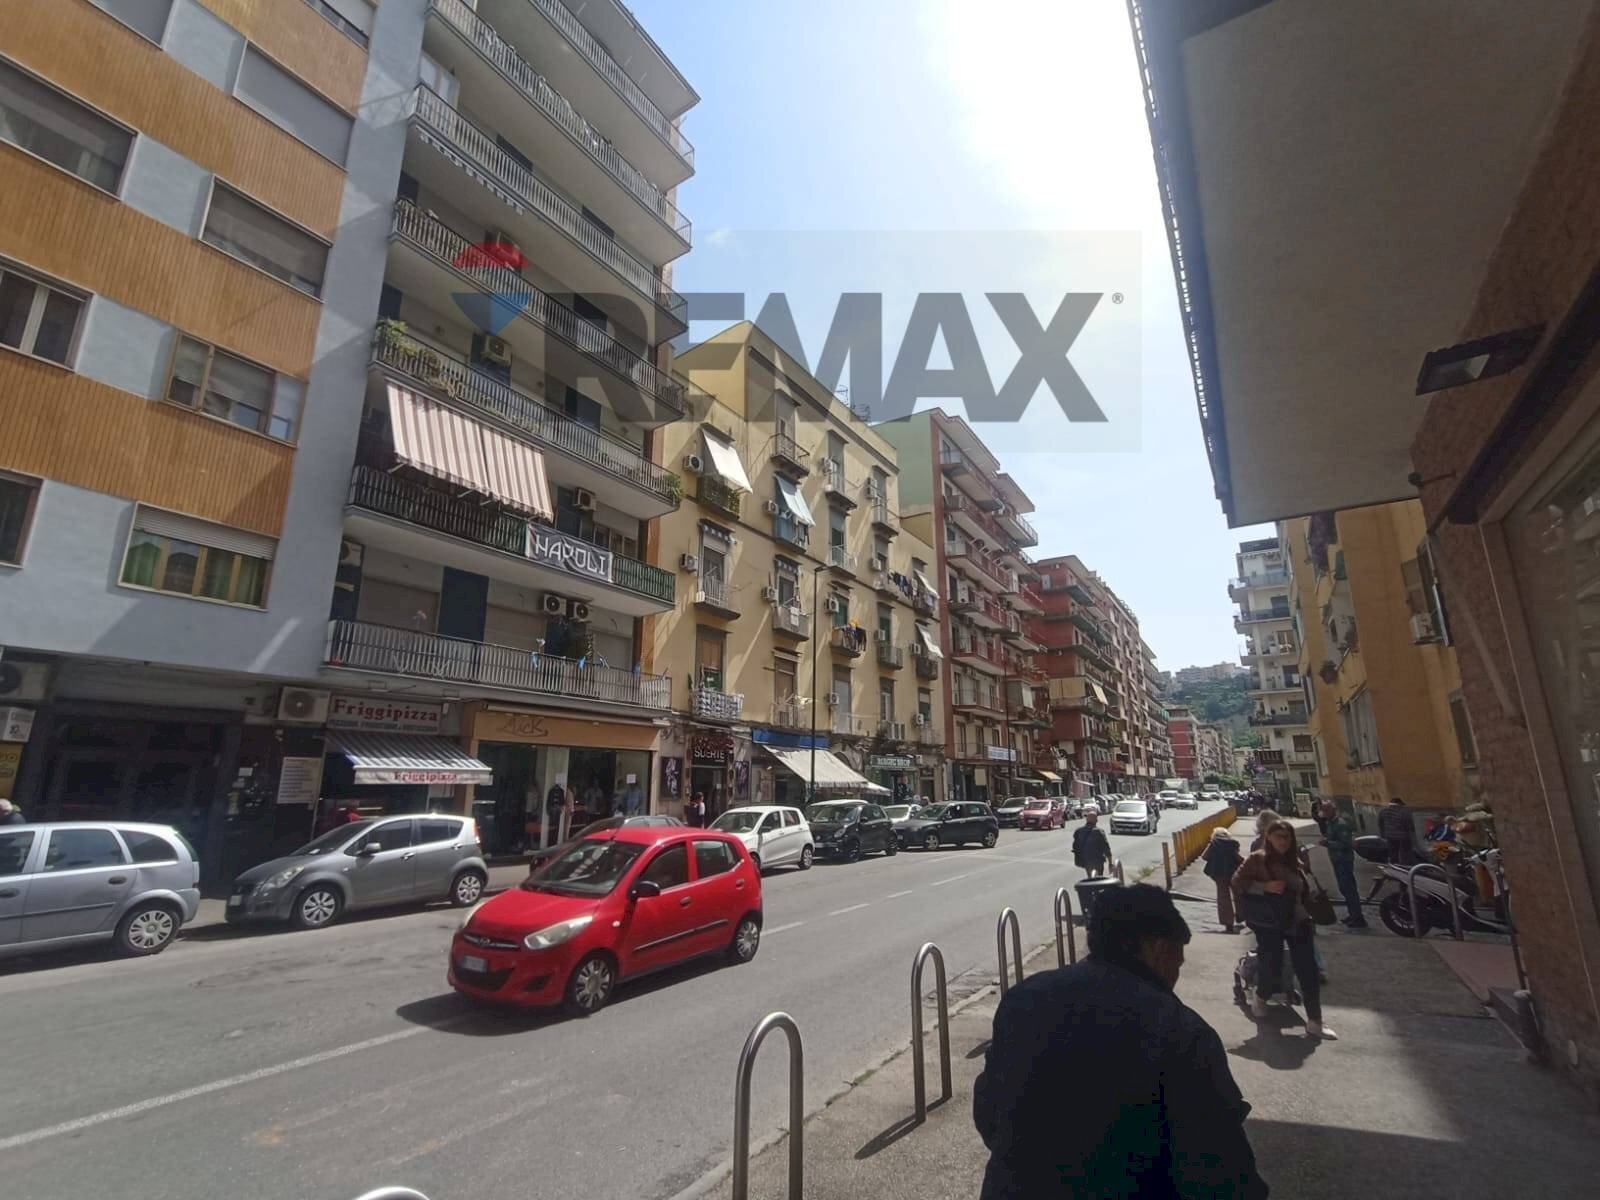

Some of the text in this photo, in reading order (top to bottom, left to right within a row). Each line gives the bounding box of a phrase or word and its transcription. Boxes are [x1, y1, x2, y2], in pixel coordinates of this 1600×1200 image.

[535, 534, 606, 575] NAPOLI
[334, 699, 438, 722] Friggipizza
[394, 771, 457, 782] Friggipizza
